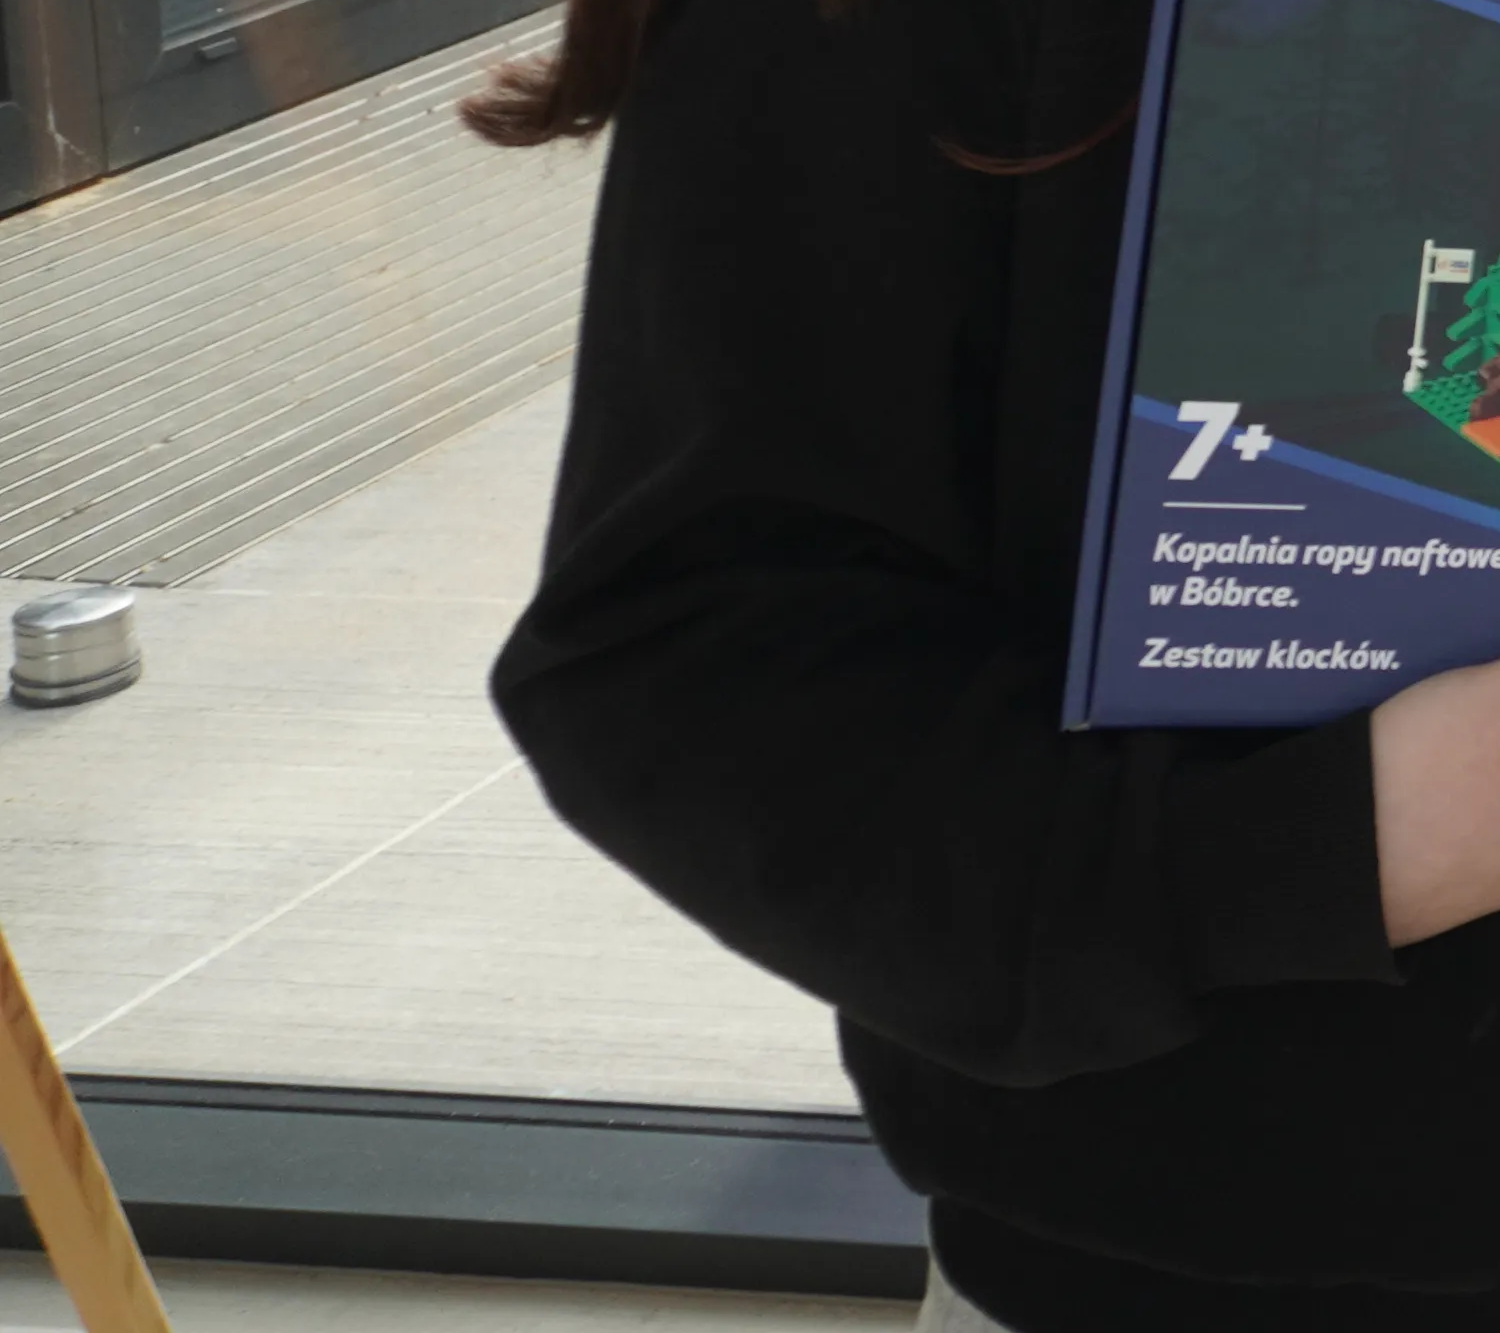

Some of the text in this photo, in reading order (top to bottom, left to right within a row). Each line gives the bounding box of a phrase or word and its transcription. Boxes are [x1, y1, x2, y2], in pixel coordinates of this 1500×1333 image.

[1168, 400, 1274, 481] 7+
[1153, 532, 1298, 572] Kopalnia
[1302, 544, 1376, 575] ropy
[1149, 576, 1300, 608] w Bóbrce.
[1139, 638, 1401, 670] Zestaw klocków.
